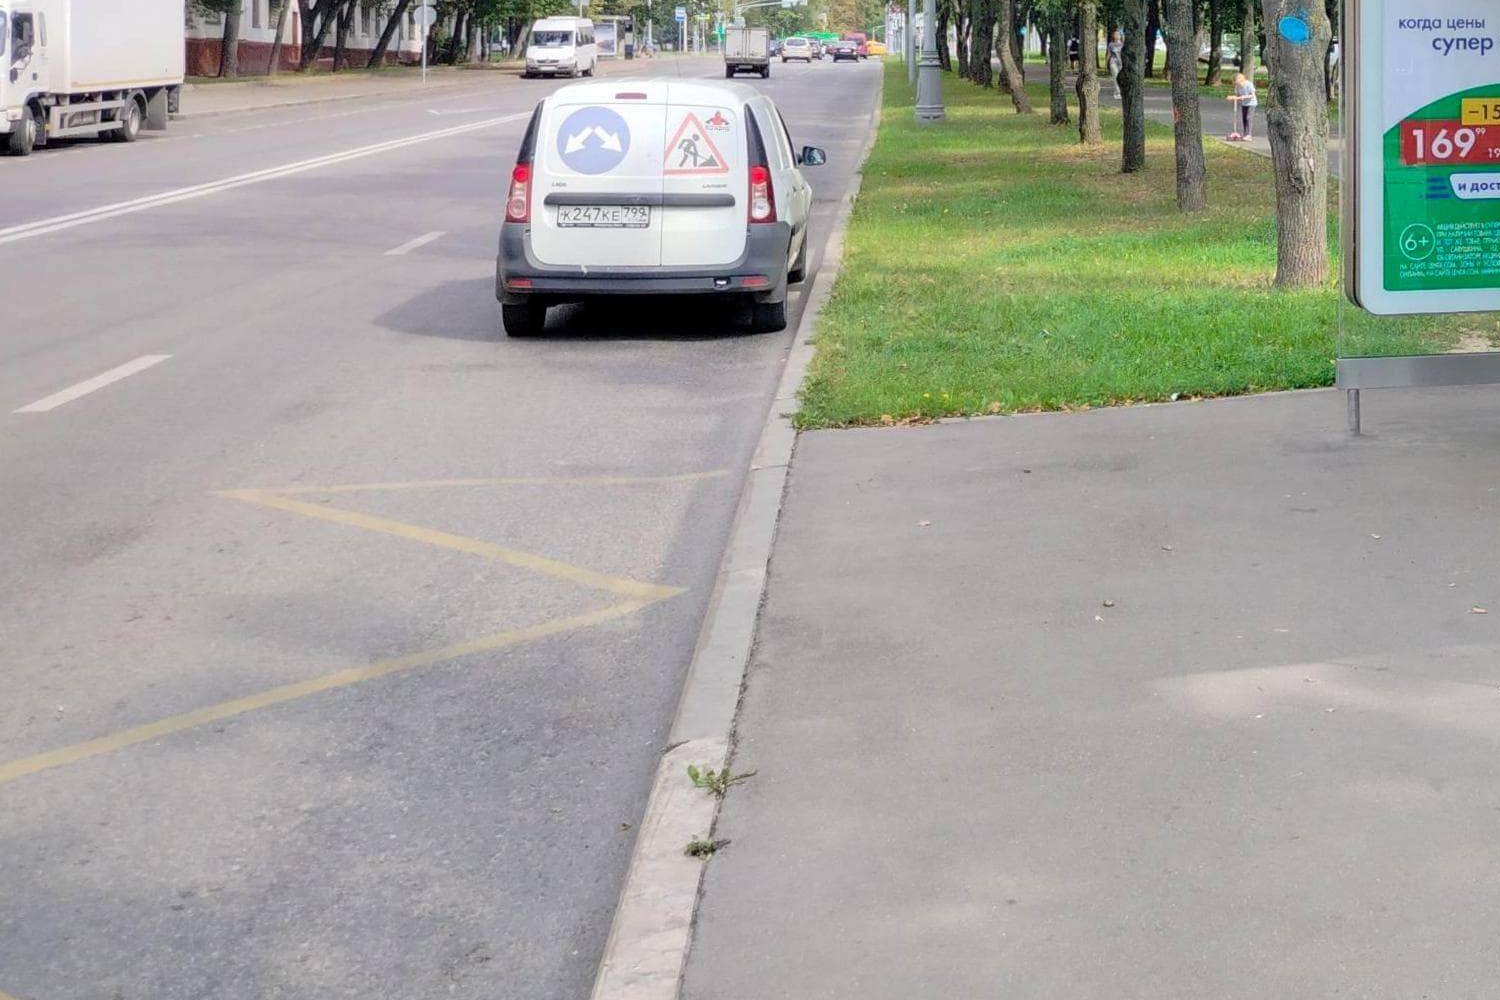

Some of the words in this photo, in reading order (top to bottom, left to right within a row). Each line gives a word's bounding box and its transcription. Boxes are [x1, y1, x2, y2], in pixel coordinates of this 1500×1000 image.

[1399, 17, 1441, 30] когда
[1446, 18, 1485, 30] цены
[1432, 36, 1493, 55] супер
[1458, 182, 1466, 191] и
[1405, 231, 1430, 251] 6+
